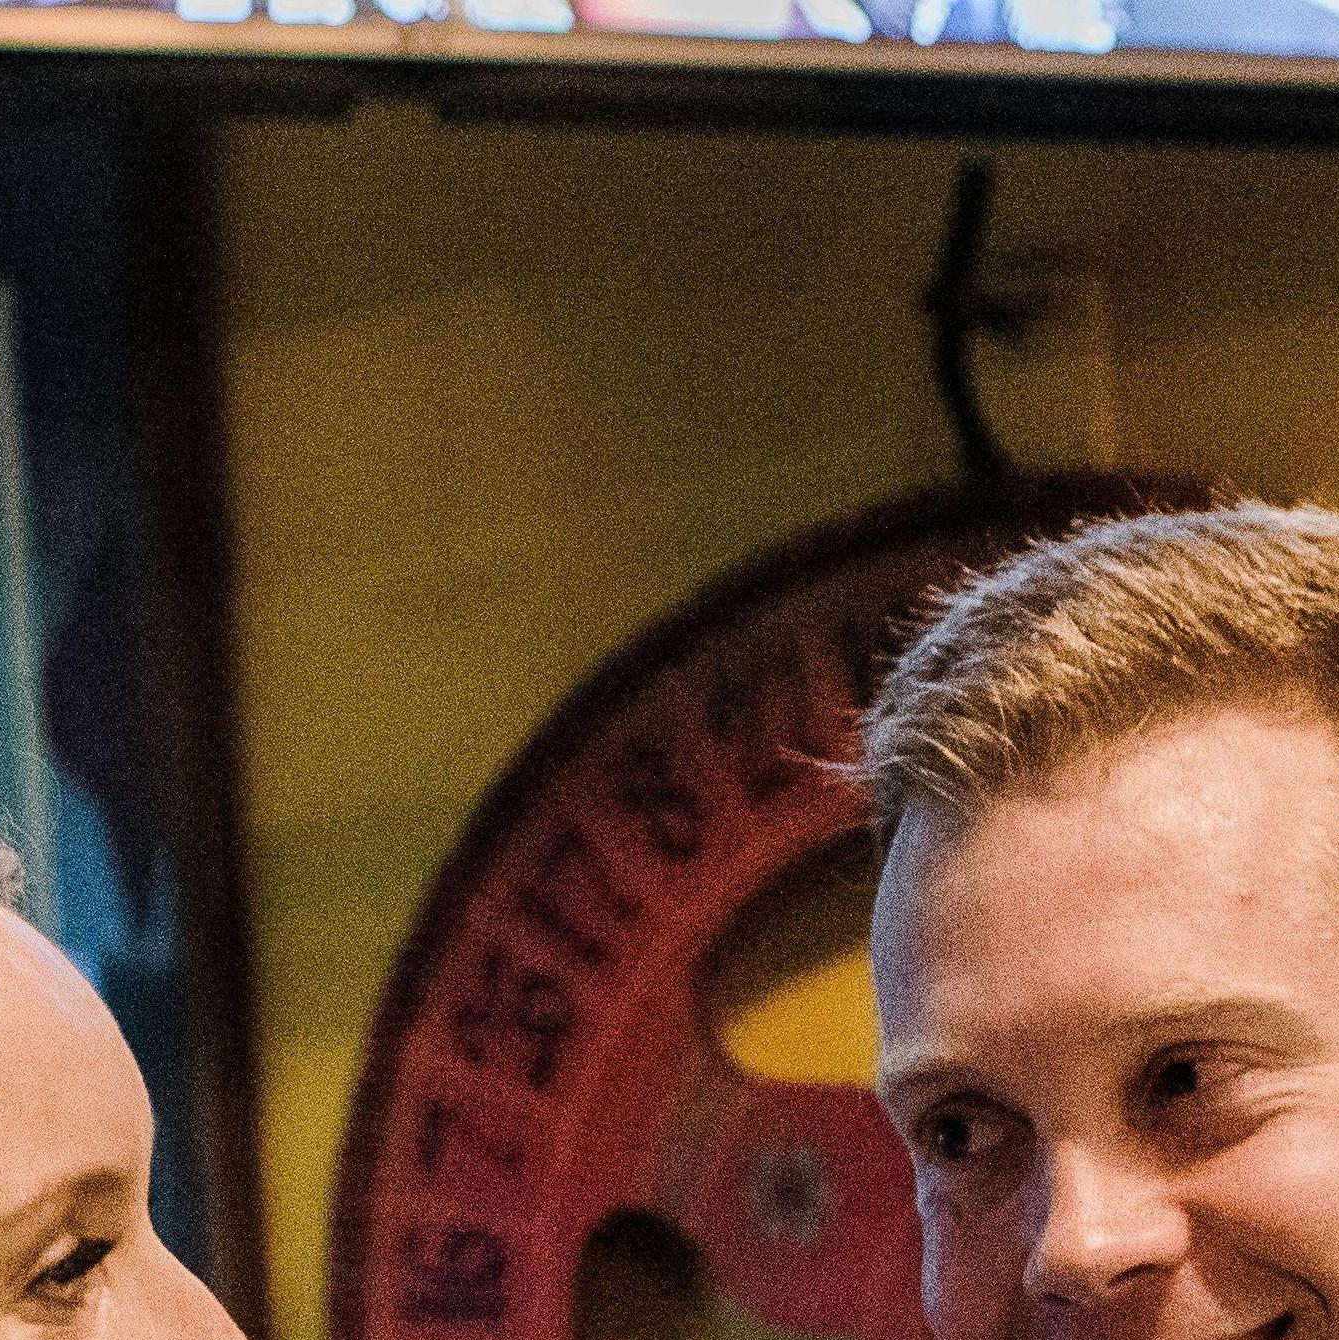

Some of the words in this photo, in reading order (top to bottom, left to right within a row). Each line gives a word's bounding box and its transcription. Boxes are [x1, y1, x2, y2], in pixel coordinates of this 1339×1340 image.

[622, 748, 704, 863] 8
[520, 828, 643, 968] 17
[418, 1097, 522, 1185] 7
[396, 1225, 509, 1324] 16
